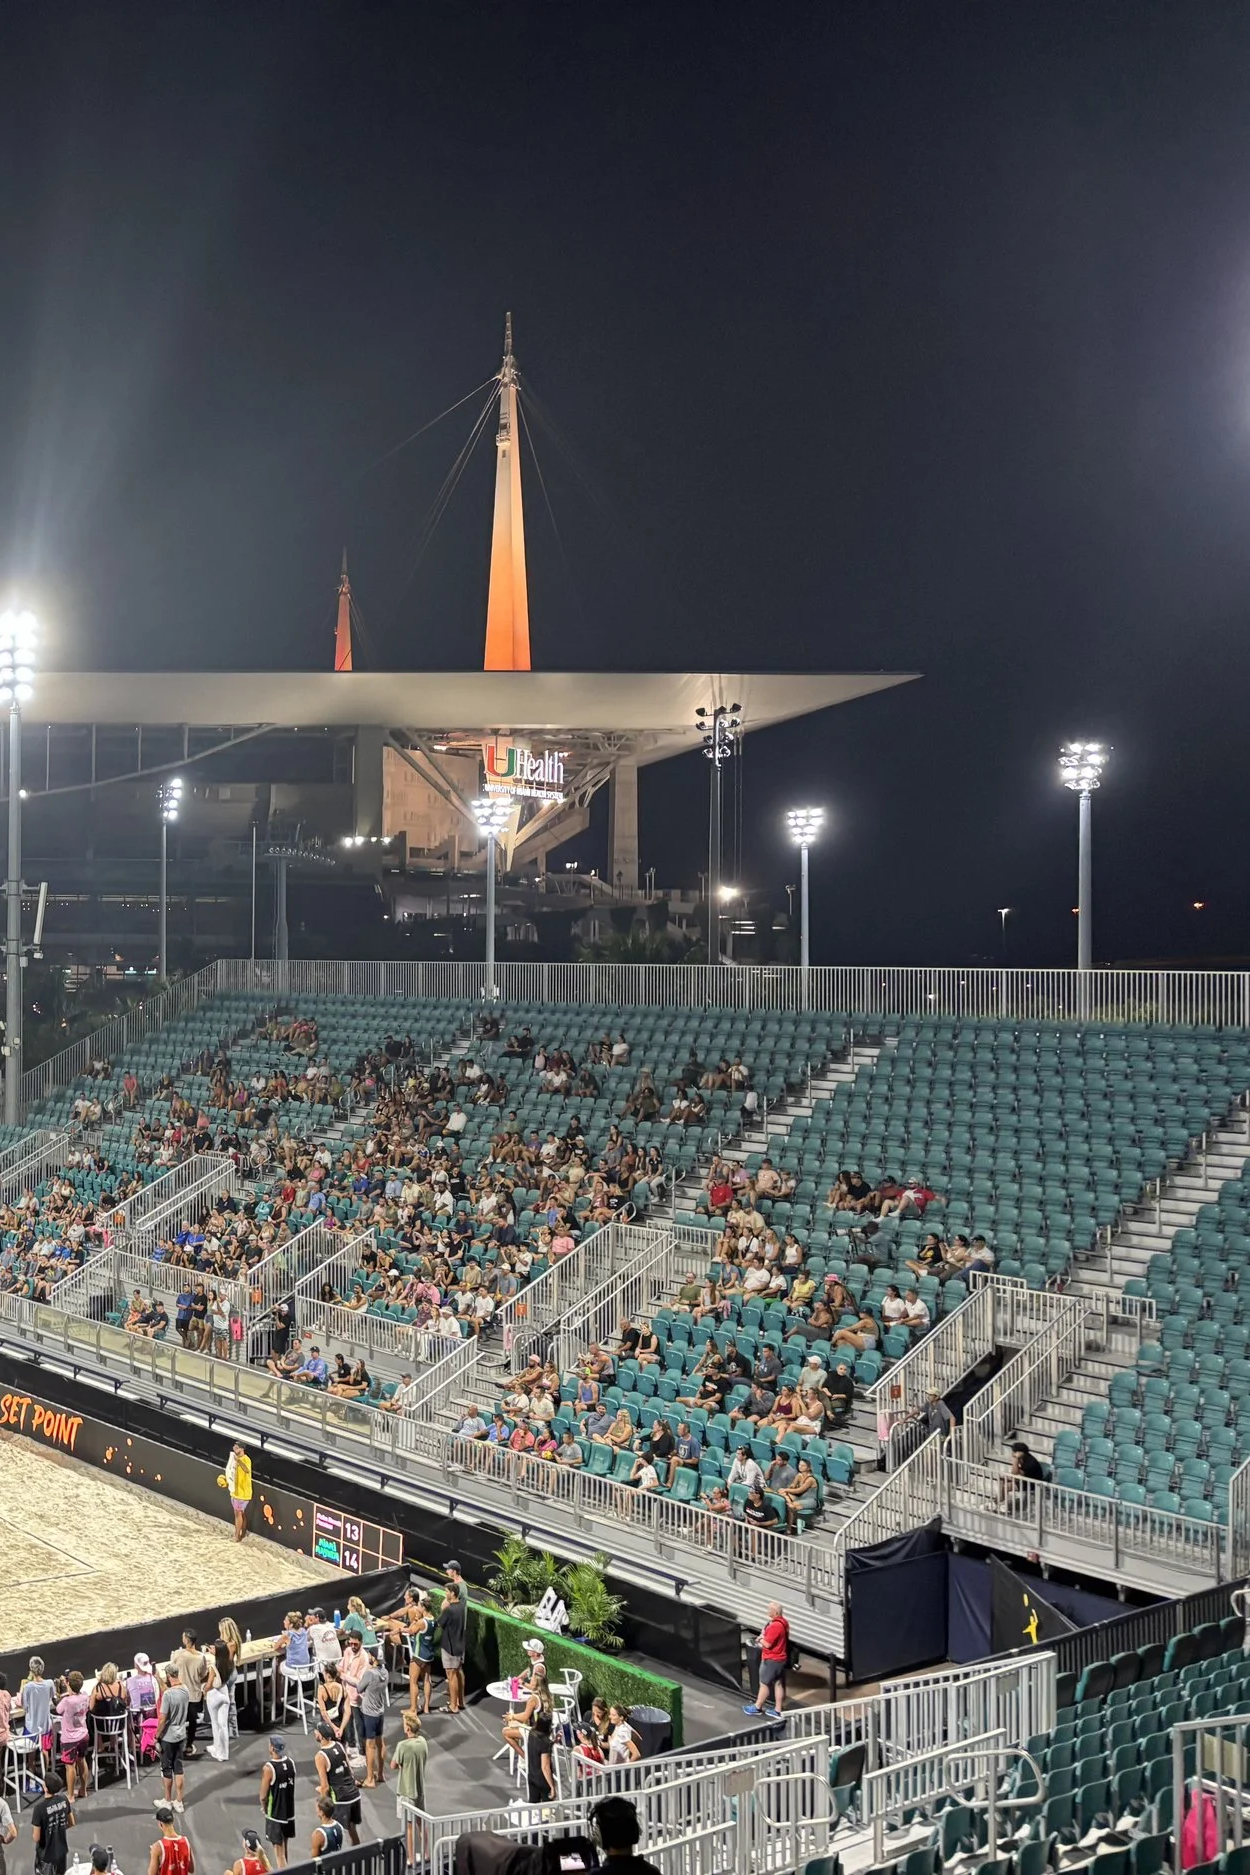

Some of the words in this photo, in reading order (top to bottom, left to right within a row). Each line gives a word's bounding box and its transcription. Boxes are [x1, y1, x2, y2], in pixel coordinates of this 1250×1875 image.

[487, 744, 564, 784] UHealth
[32, 1404, 84, 1452] POINT
[345, 1522, 359, 1541] 13
[344, 1550, 358, 1570] 14
